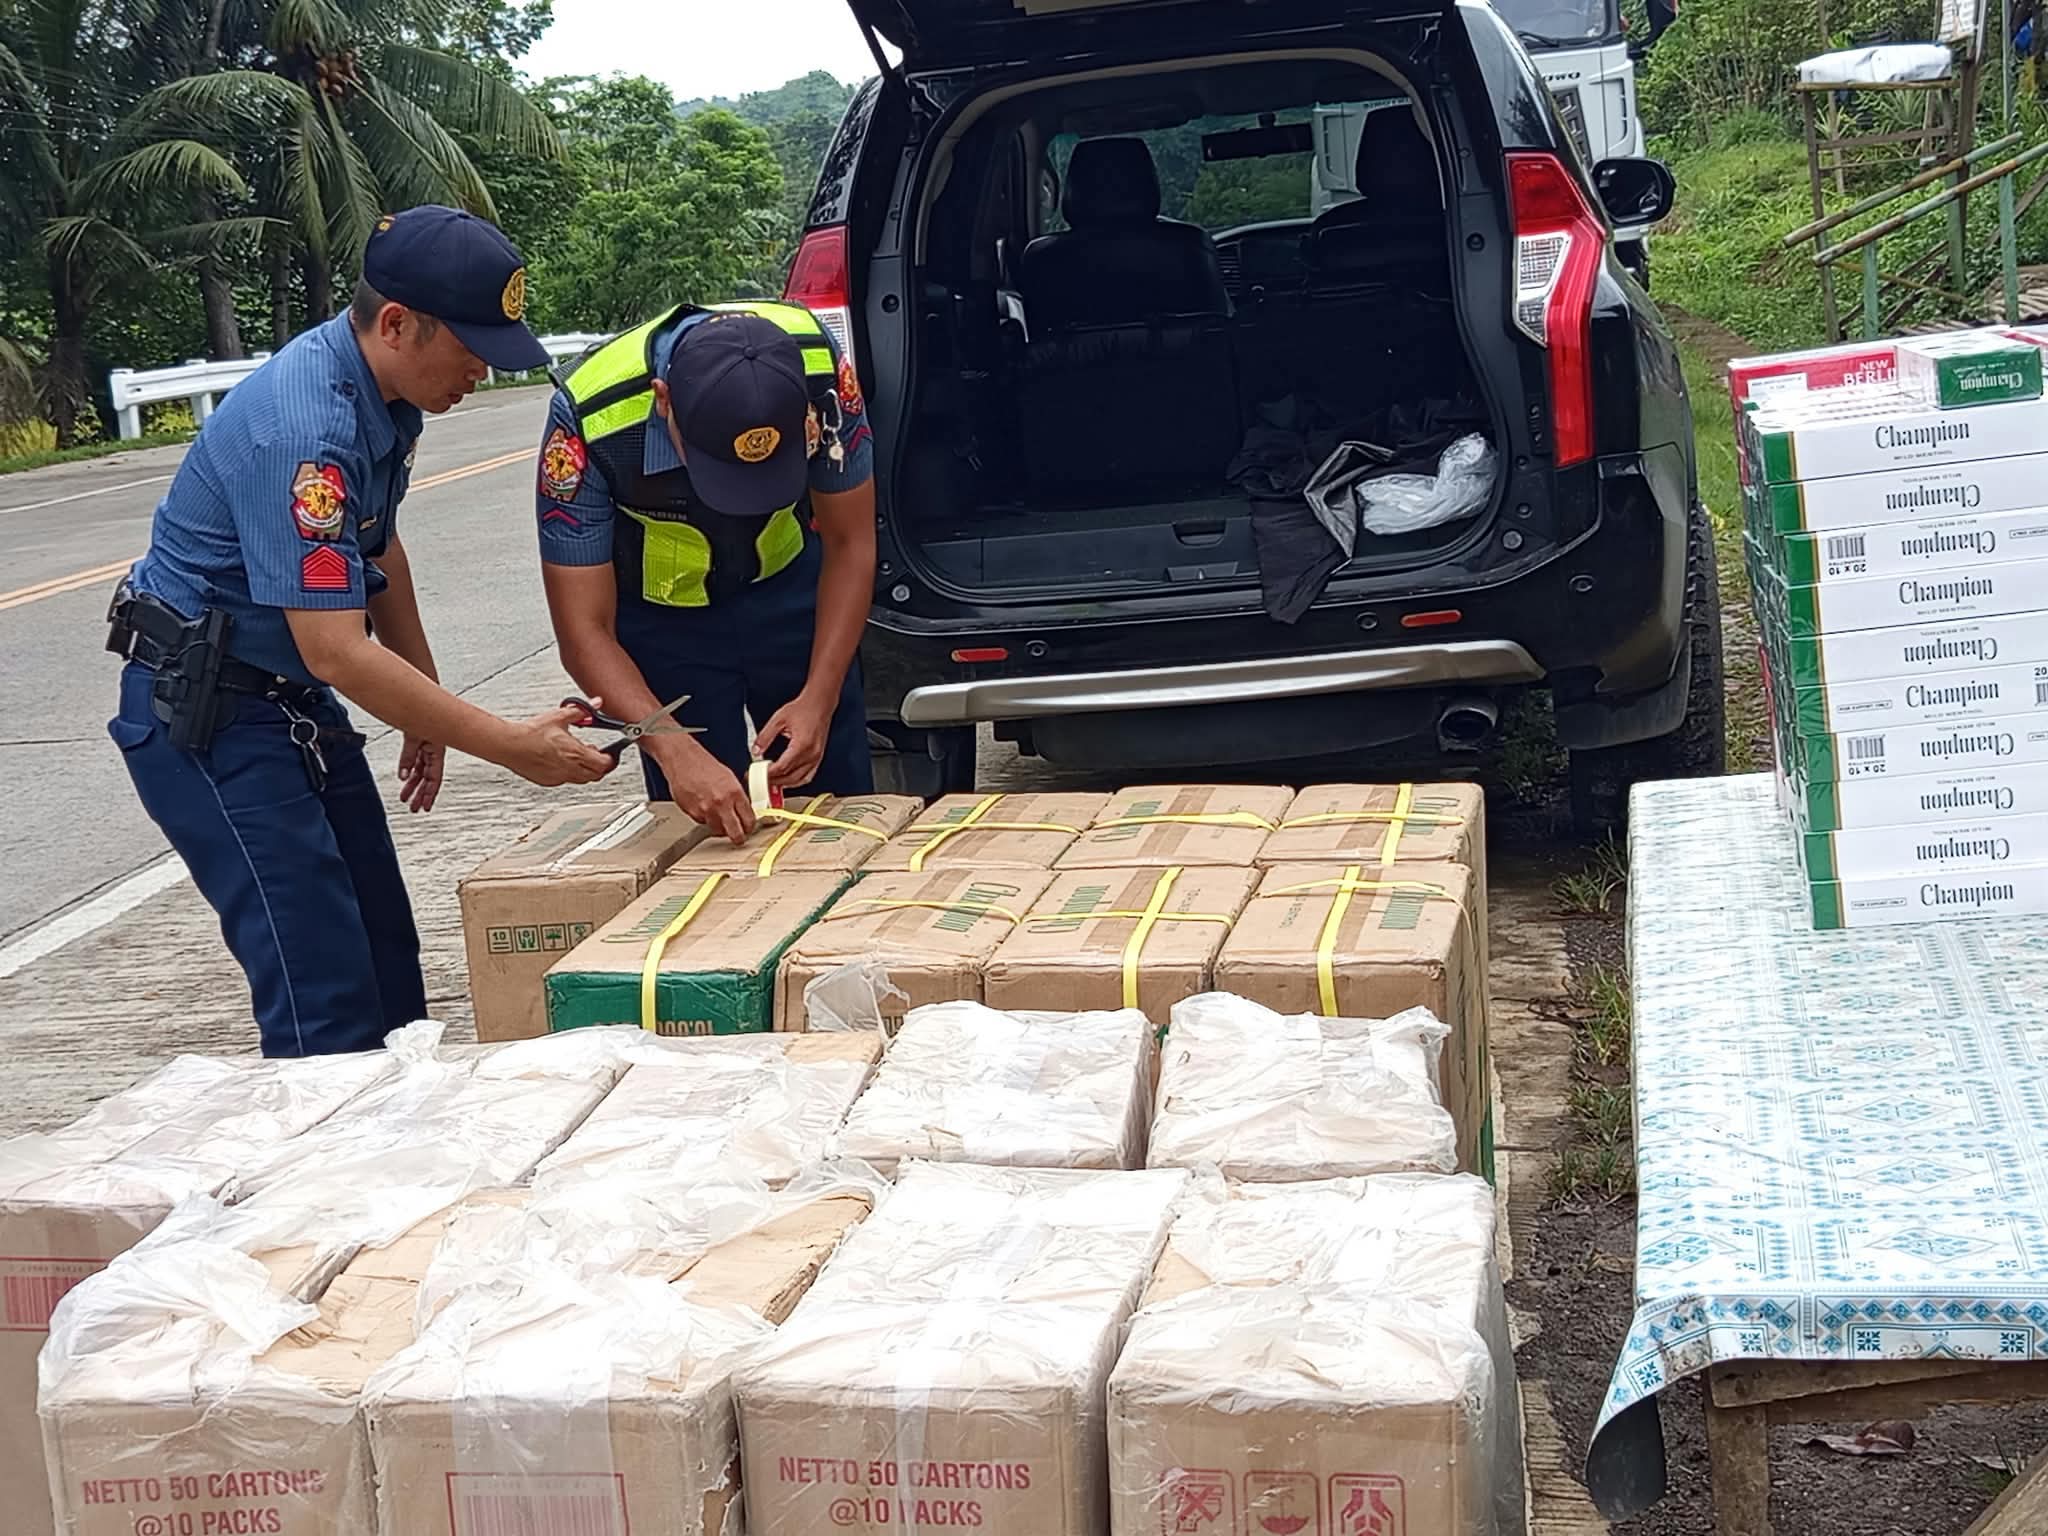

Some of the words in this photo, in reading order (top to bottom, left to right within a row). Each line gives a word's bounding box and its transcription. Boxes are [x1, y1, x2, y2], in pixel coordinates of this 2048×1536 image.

[1843, 367, 1897, 386] BERLI
[1859, 360, 1889, 371] NEW
[1959, 371, 2024, 392] Champion
[1876, 421, 1969, 448] Champion
[1887, 485, 1980, 512] Champion
[1902, 531, 1995, 558] Champion
[1829, 566, 1840, 576] 10
[1844, 565, 1851, 573] x
[1853, 563, 1867, 573] 20
[1900, 577, 1992, 604] Champion
[1904, 638, 1997, 664] Champion
[2034, 667, 2048, 677] 20
[1907, 681, 1999, 707] Champion
[1921, 734, 2013, 759] Champion
[1849, 766, 1861, 776] 10
[1864, 765, 1871, 773] x
[1873, 763, 1886, 773] 20
[1921, 787, 2013, 812] Champion
[1917, 838, 2009, 863] Champion
[1921, 882, 2013, 907] Champion
[776, 1457, 859, 1484] NETTO
[869, 1462, 898, 1486] 50
[908, 1463, 1031, 1489] CARTONS
[83, 1479, 161, 1504] NETTO
[170, 1476, 199, 1500] 50
[208, 1470, 324, 1497] CARTONS
[135, 1512, 193, 1536] @10
[201, 1508, 281, 1535] PACKS
[829, 1497, 890, 1526] @10
